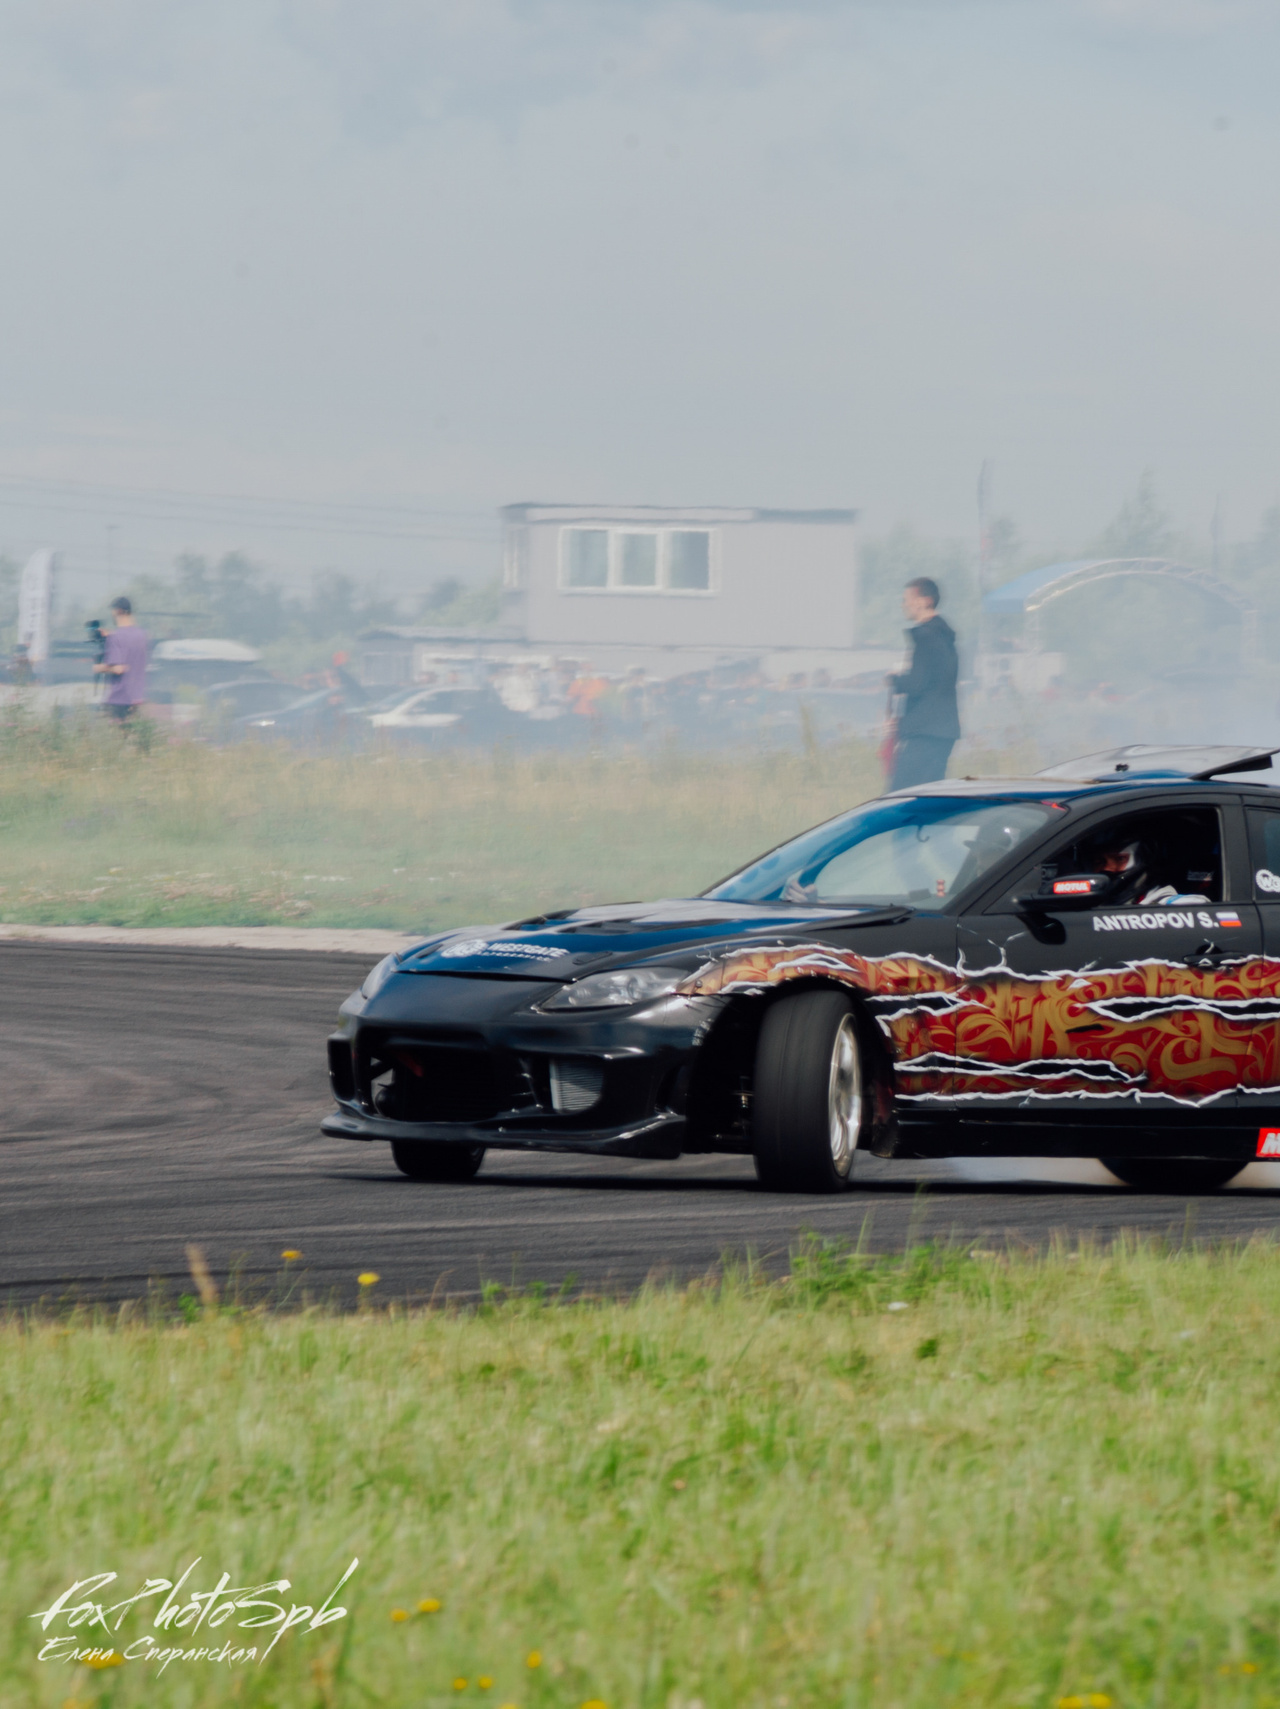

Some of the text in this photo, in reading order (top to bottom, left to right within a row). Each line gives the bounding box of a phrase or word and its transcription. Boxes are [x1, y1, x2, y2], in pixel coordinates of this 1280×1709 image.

[1055, 882, 1089, 892] MOTUL
[1092, 911, 1220, 932] ANTROPOV S.
[487, 942, 570, 957] WESTGATE
